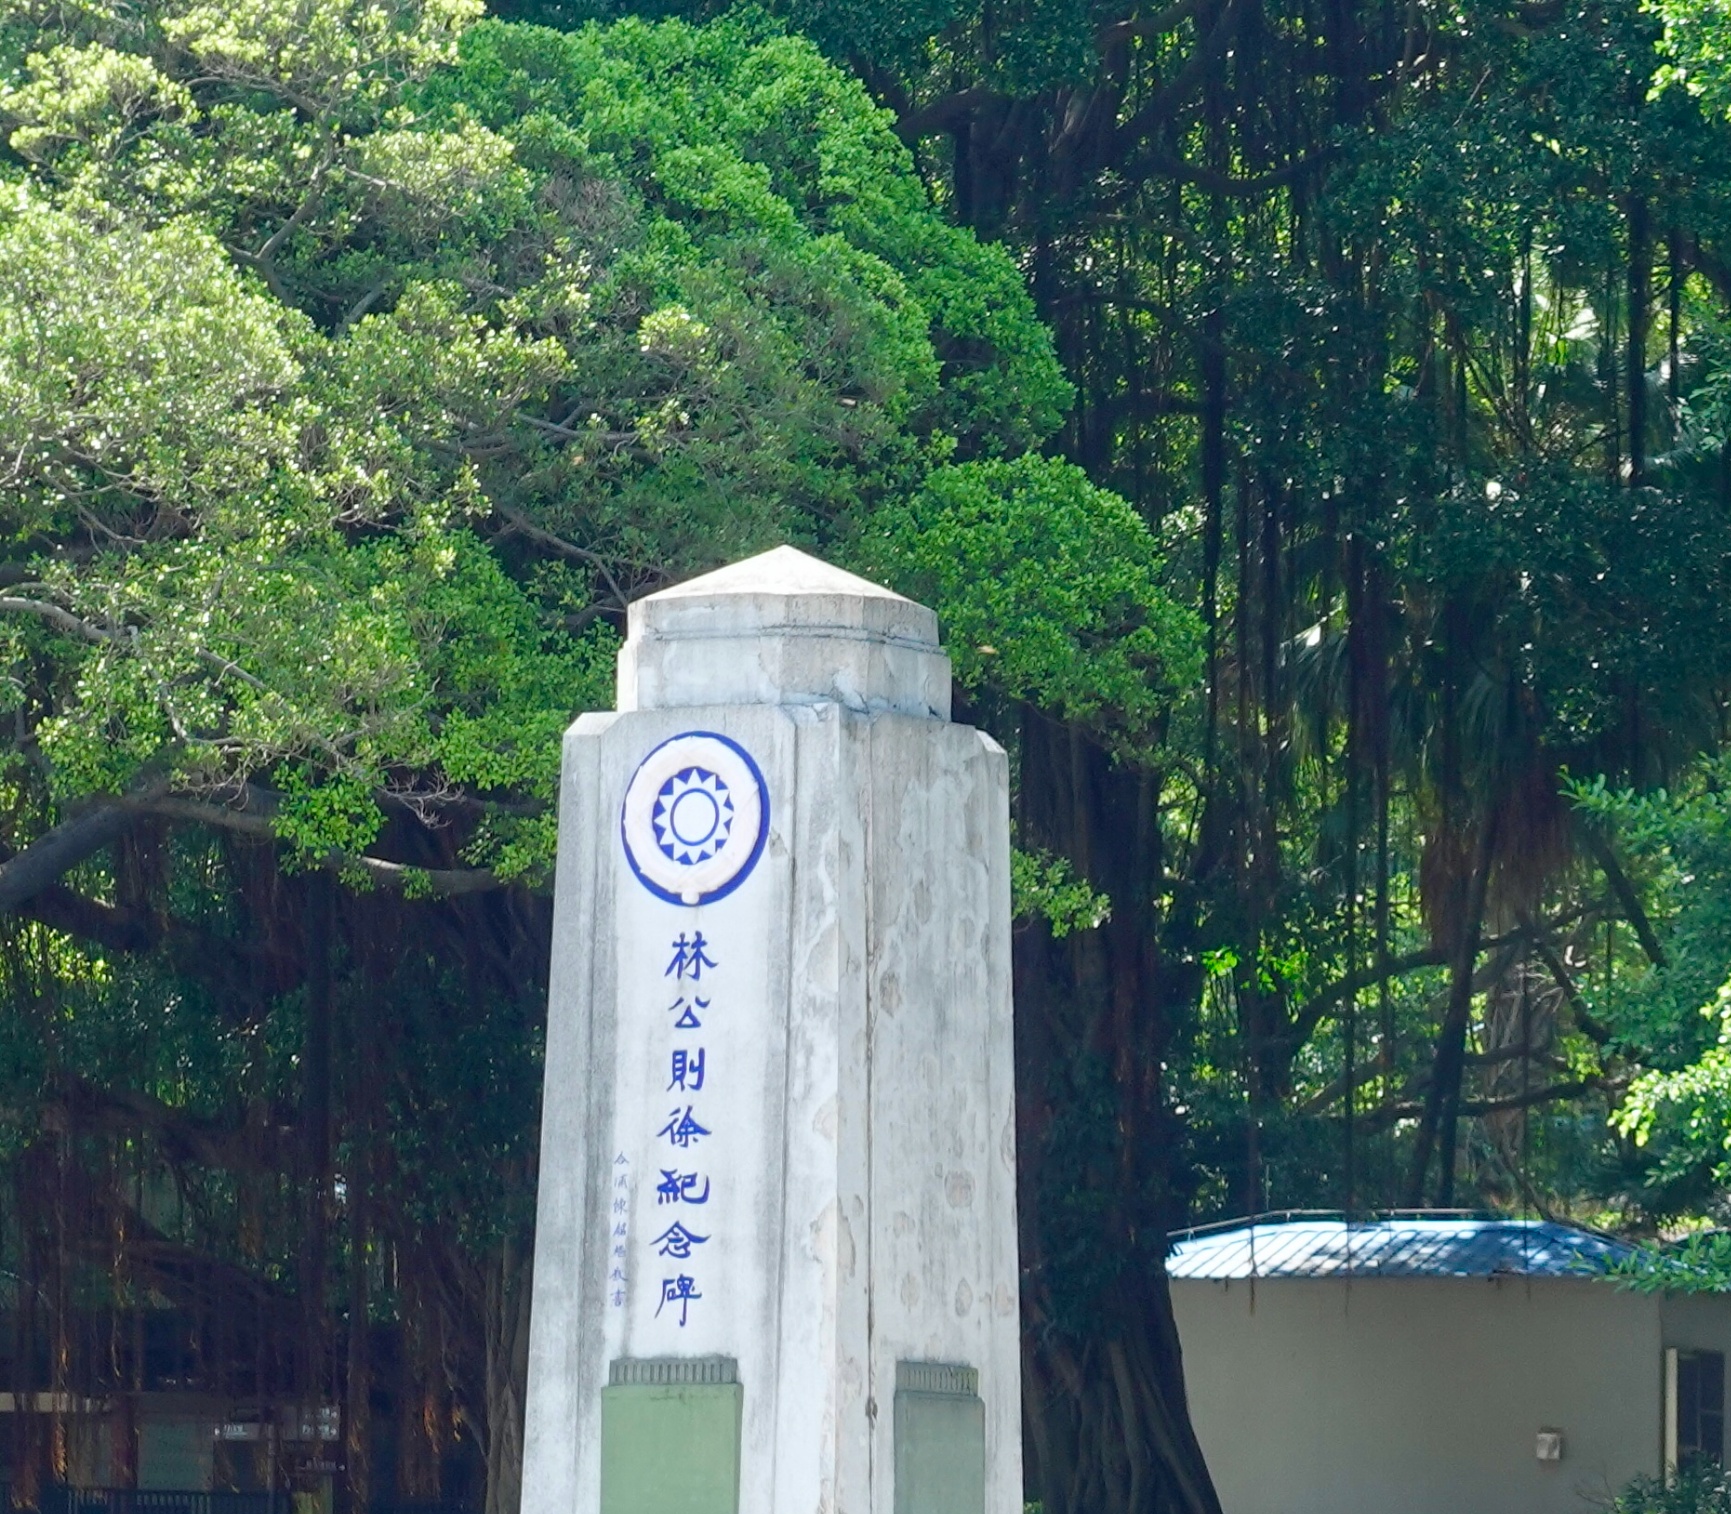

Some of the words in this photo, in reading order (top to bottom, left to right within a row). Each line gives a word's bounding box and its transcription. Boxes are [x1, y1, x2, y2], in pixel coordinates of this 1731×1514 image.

[650, 930, 718, 1328] 林公則徐紀念碑
